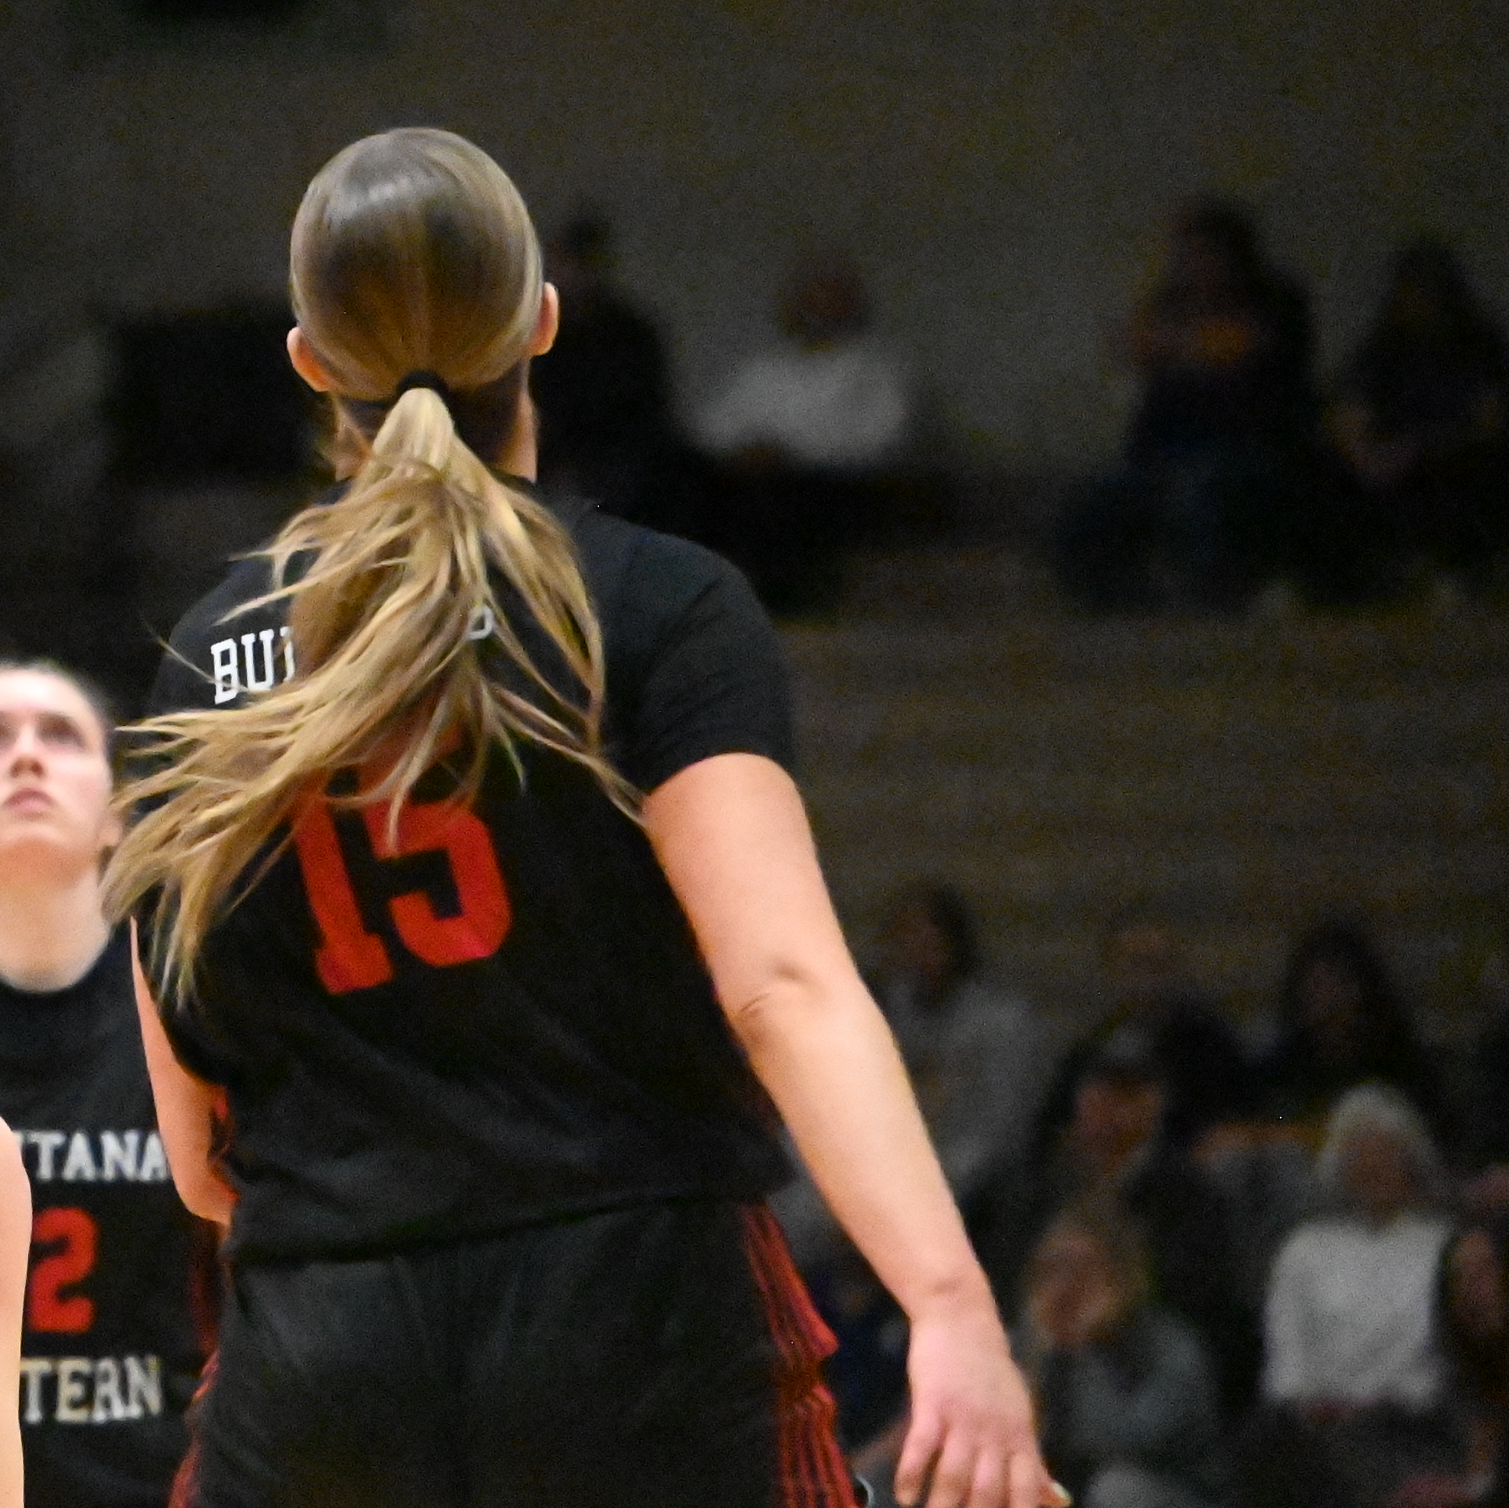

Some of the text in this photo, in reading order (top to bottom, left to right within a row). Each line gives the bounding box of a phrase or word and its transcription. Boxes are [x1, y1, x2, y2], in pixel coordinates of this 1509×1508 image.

[293, 728, 513, 995] 15
[14, 1128, 169, 1182] TANA
[19, 1354, 162, 1424] TERN
